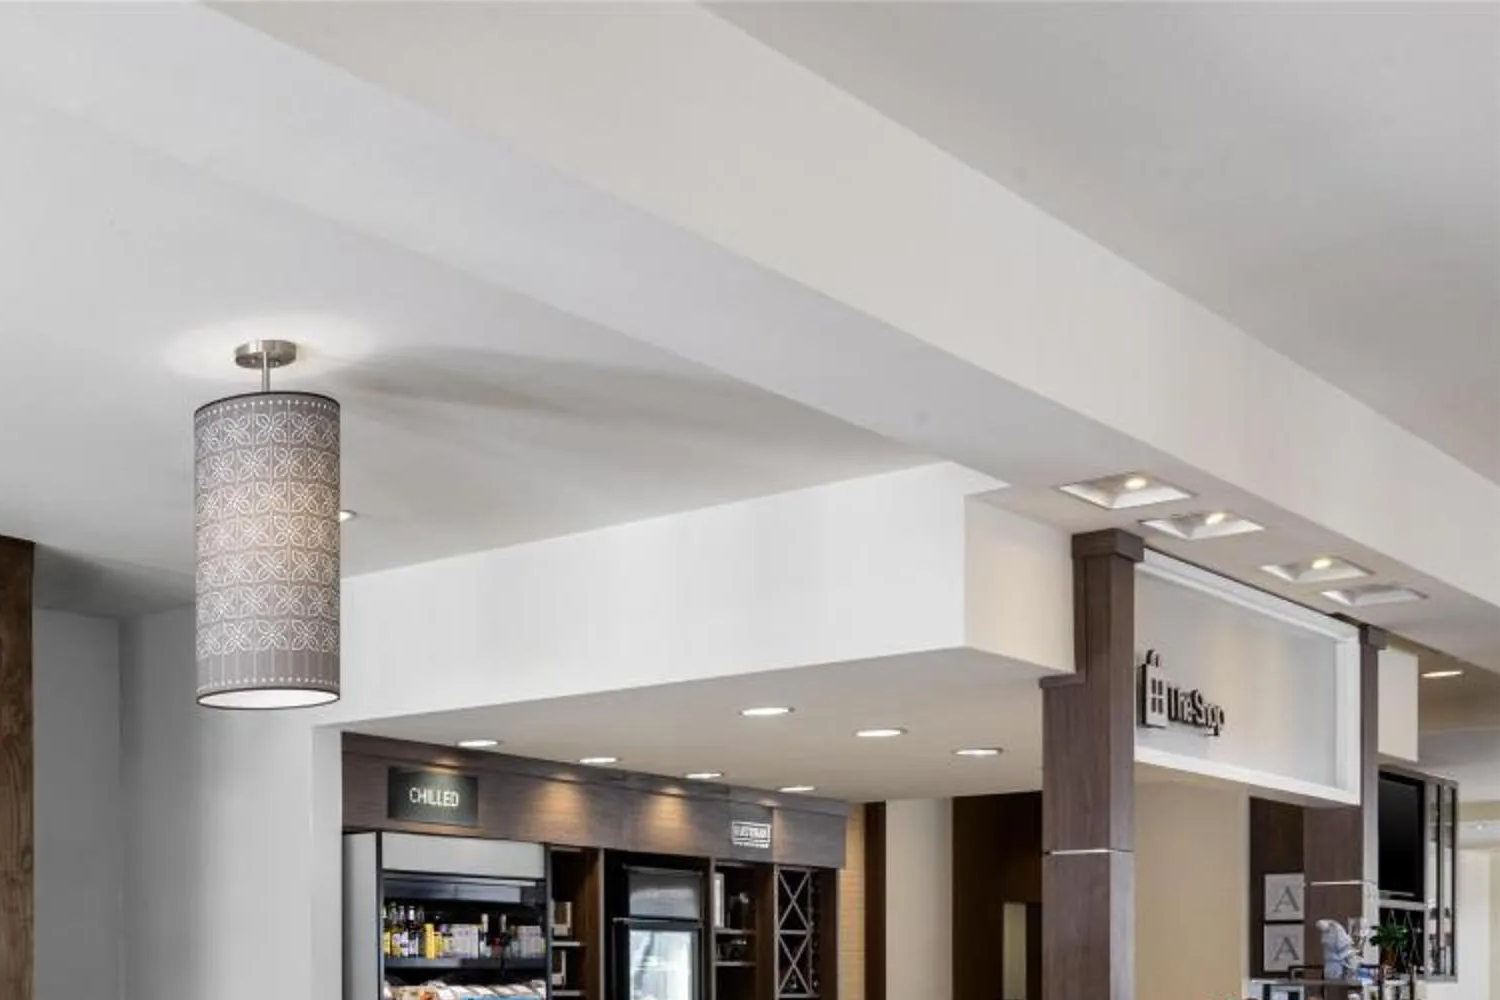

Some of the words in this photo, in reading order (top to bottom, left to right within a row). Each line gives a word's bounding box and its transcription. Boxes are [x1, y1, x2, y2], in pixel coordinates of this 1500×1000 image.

[408, 786, 460, 807] CHILLED
[1273, 886, 1300, 913] A
[1273, 936, 1300, 961] A
